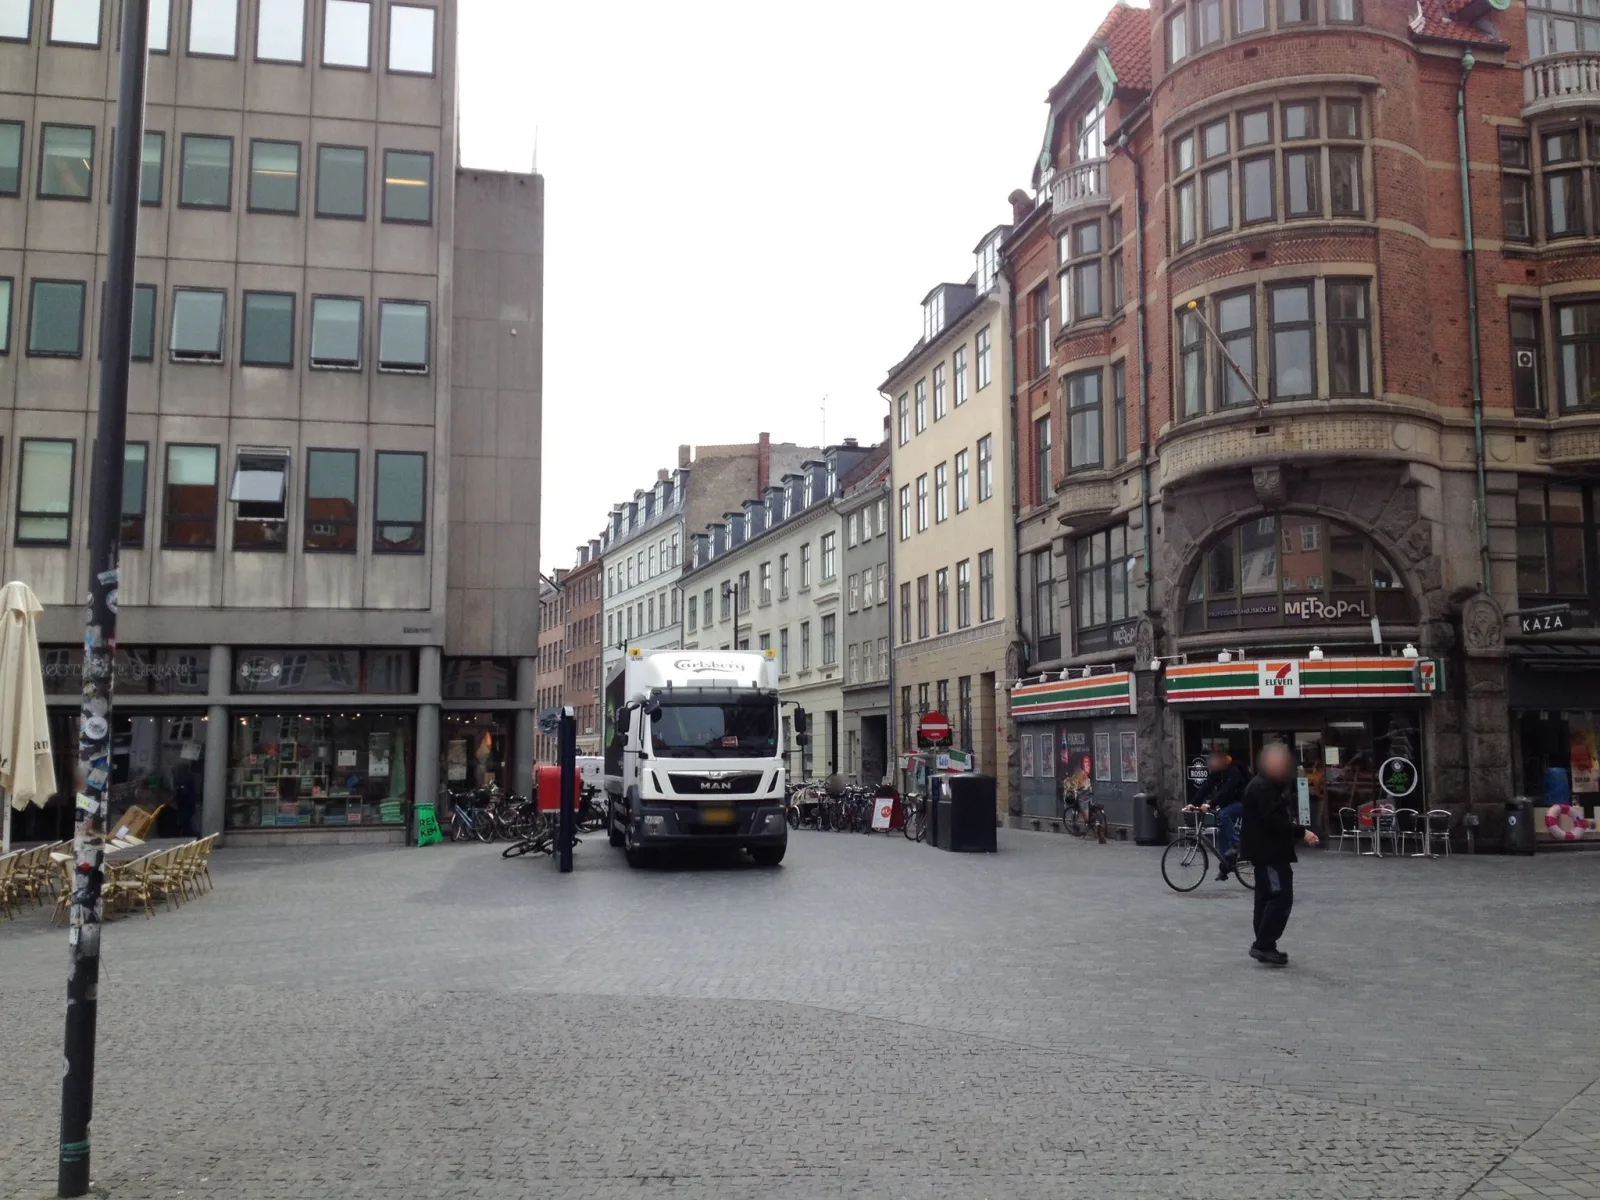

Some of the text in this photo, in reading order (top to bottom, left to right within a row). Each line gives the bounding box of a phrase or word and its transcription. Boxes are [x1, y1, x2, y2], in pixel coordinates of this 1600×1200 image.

[1284, 597, 1370, 619] METROPOL
[1523, 616, 1563, 631] KAZA
[1113, 626, 1137, 645] METROP
[673, 659, 745, 673] Carlsberg
[700, 782, 732, 790] MAN
